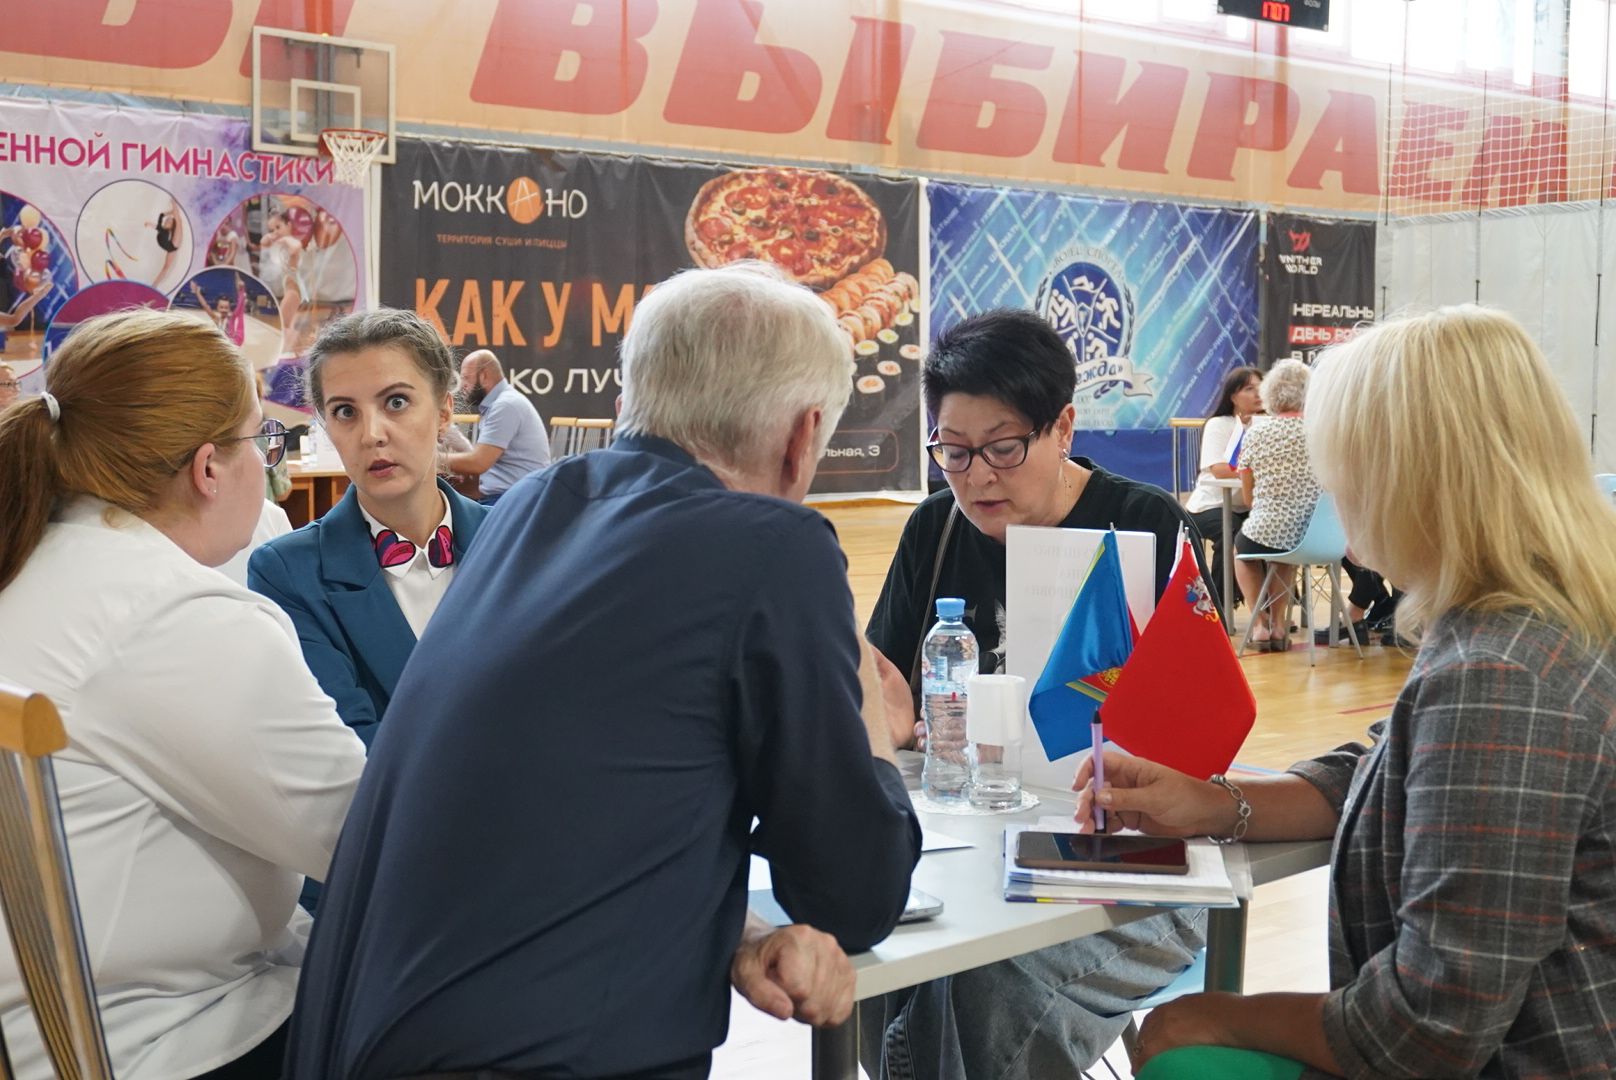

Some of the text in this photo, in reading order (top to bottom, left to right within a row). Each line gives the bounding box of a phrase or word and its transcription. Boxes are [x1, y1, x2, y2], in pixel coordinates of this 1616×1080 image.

[121, 143, 335, 185] ГИМНАСТИКИ
[412, 178, 588, 220] МОККАНО
[415, 278, 527, 346] КАК
[541, 282, 572, 347] У
[1292, 326, 1332, 342] ДЕНЬ
